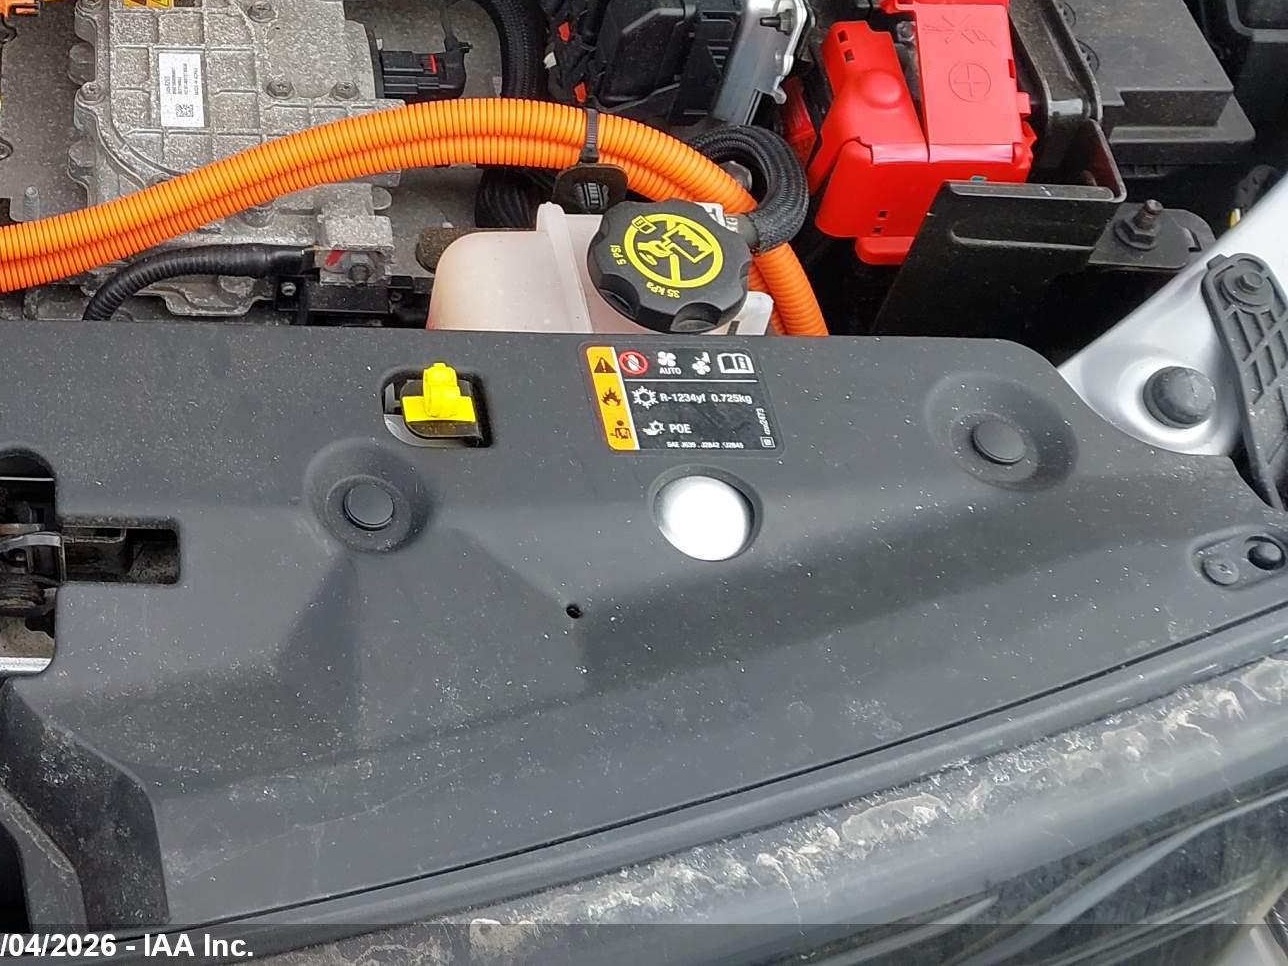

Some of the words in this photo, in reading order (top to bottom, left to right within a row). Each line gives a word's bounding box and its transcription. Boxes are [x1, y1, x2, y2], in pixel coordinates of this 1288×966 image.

[610, 245, 624, 257] PSI
[646, 282, 667, 296] kPa
[668, 288, 680, 298] 35
[659, 367, 682, 375] AUTO
[660, 393, 706, 404] R-1234yf
[711, 394, 752, 404] 0.725kg
[669, 424, 692, 434] POE
